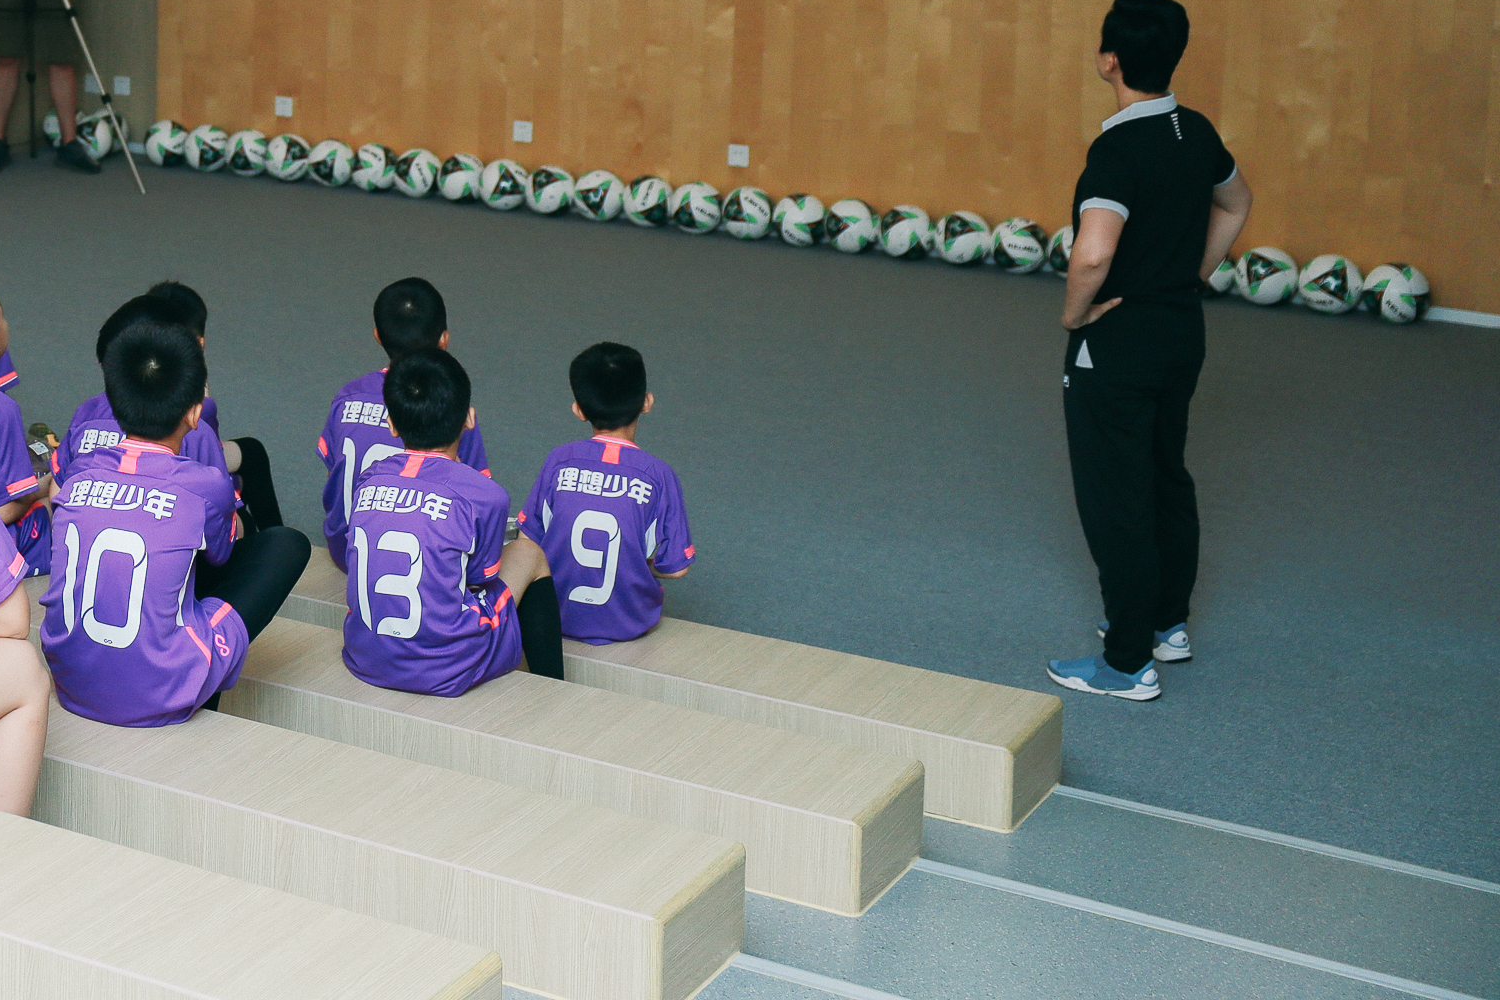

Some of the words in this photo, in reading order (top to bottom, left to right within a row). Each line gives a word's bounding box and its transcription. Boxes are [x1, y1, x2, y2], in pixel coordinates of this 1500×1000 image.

[63, 479, 177, 520] 理想少年
[354, 485, 453, 521] 理想少年
[556, 467, 652, 505] 理想少年
[63, 522, 148, 649] 10
[353, 526, 423, 639] 13
[568, 509, 621, 605] 9
